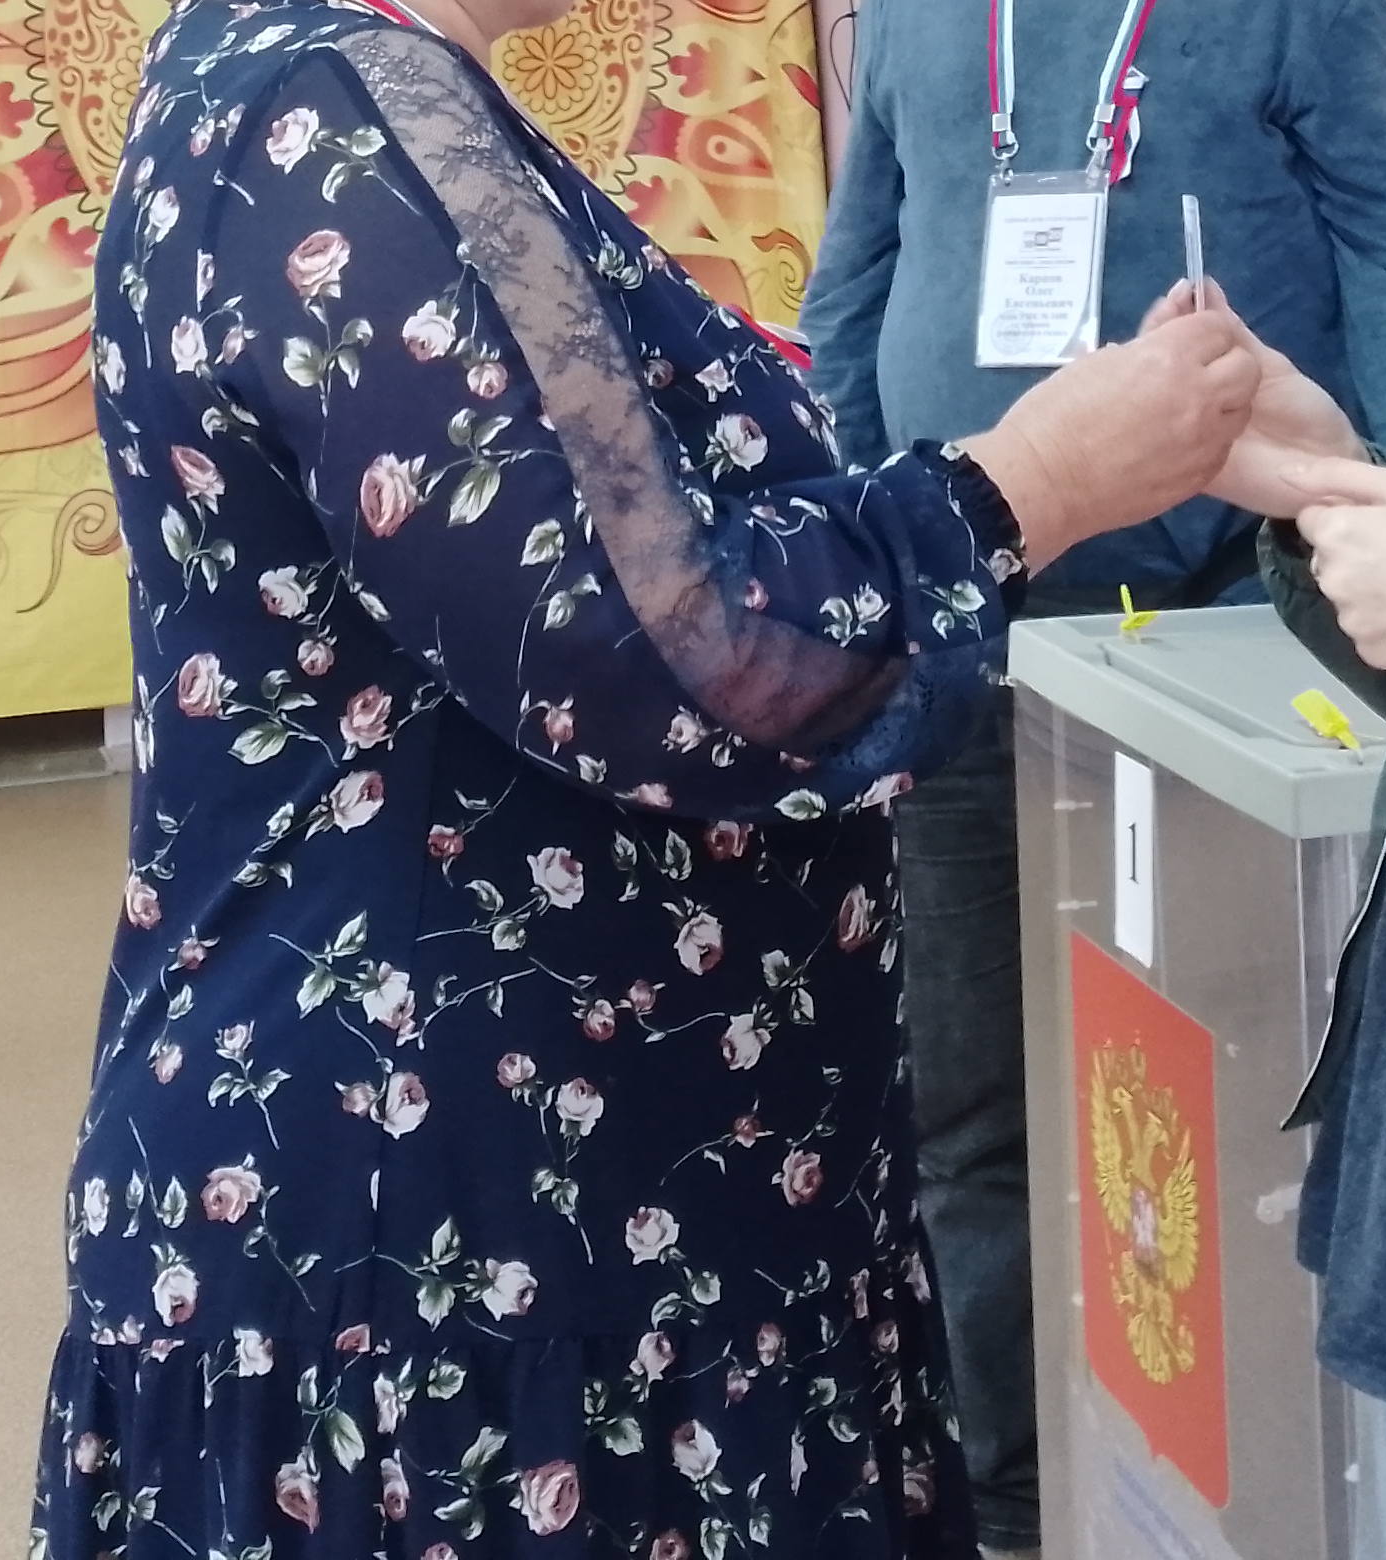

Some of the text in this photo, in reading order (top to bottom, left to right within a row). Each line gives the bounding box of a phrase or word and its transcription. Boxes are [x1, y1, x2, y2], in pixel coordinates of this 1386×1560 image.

[1025, 286, 1054, 296] Олег
[1005, 298, 1073, 308] Евгеньевич
[1128, 822, 1139, 884] 1
